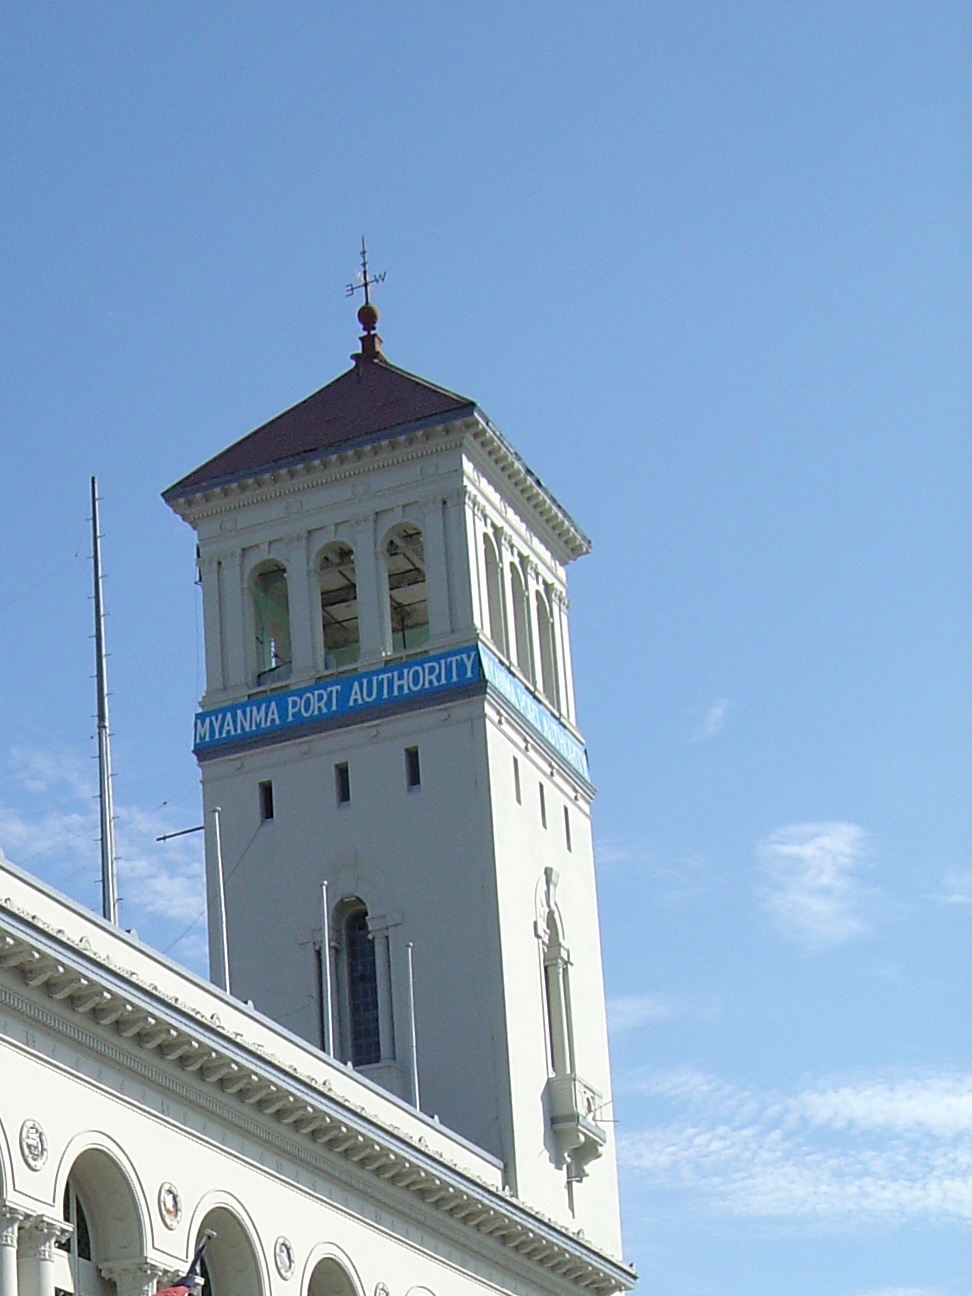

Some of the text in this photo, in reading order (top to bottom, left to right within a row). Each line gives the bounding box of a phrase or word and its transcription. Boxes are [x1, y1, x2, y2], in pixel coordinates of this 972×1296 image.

[195, 701, 280, 743] MYANMA
[286, 686, 341, 722] PORT
[348, 651, 477, 706] AUTHORITY
